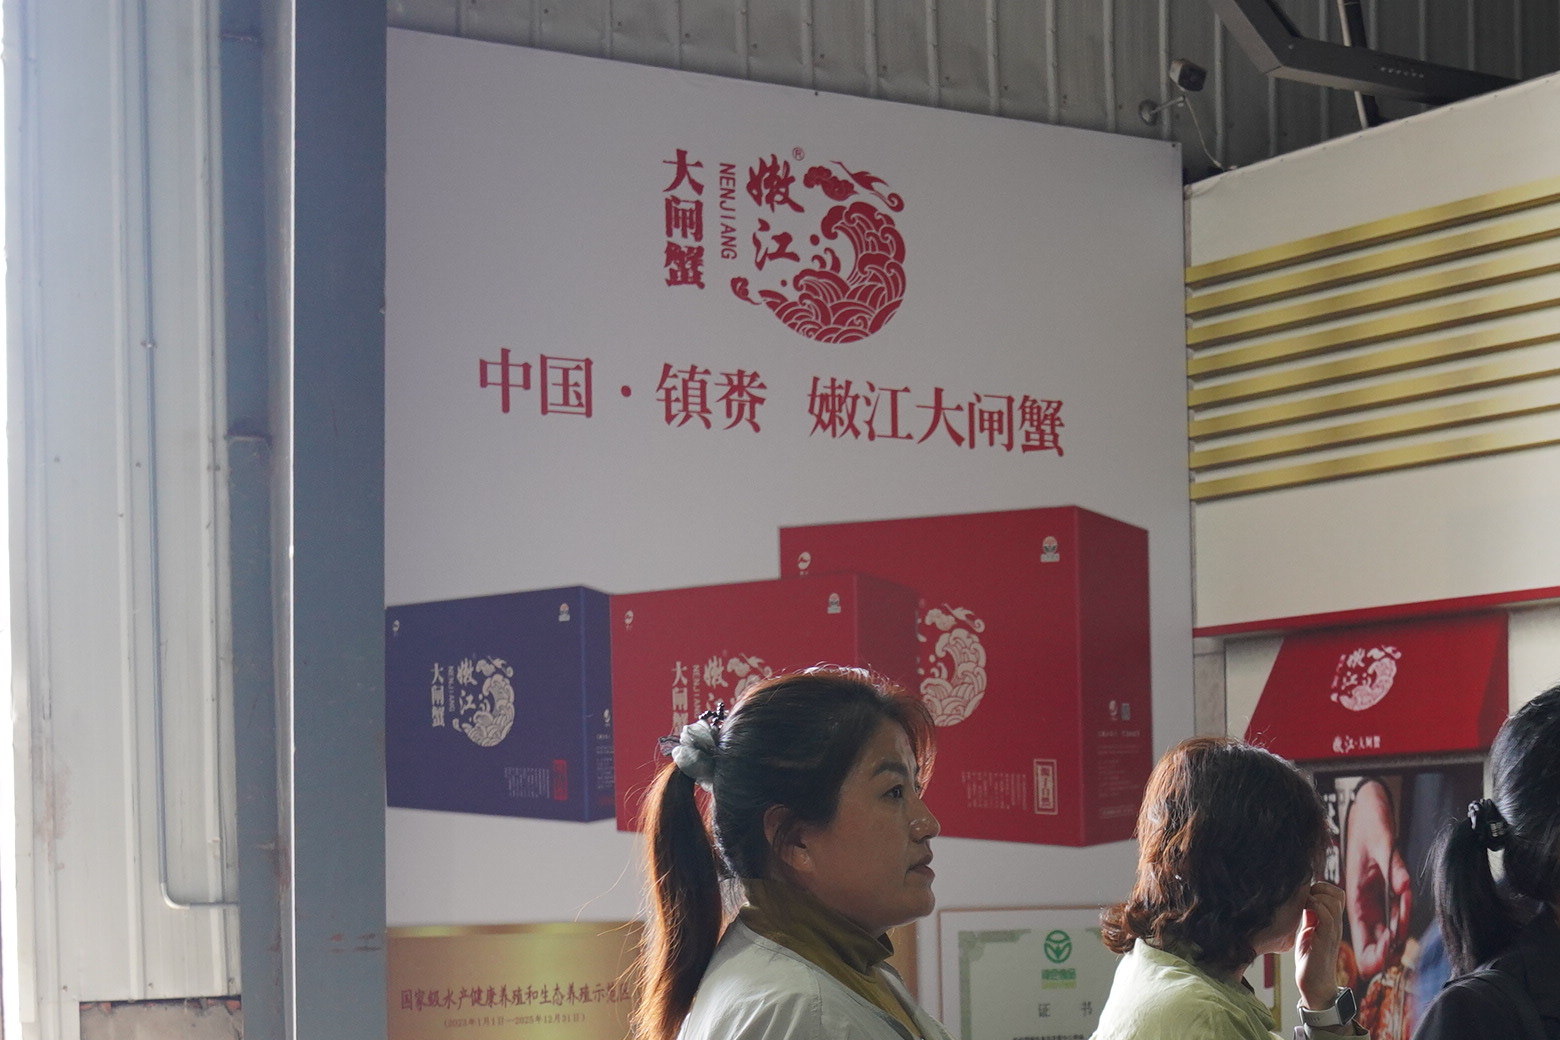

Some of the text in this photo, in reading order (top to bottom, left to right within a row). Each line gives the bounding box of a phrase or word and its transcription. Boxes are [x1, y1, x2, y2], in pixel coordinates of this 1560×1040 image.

[662, 148, 706, 290] 大闸蟹
[718, 162, 738, 261] NENJIANG
[745, 153, 805, 271] 嫩江
[479, 346, 1066, 458] 中国·镇赉 嫩江大闸蟹
